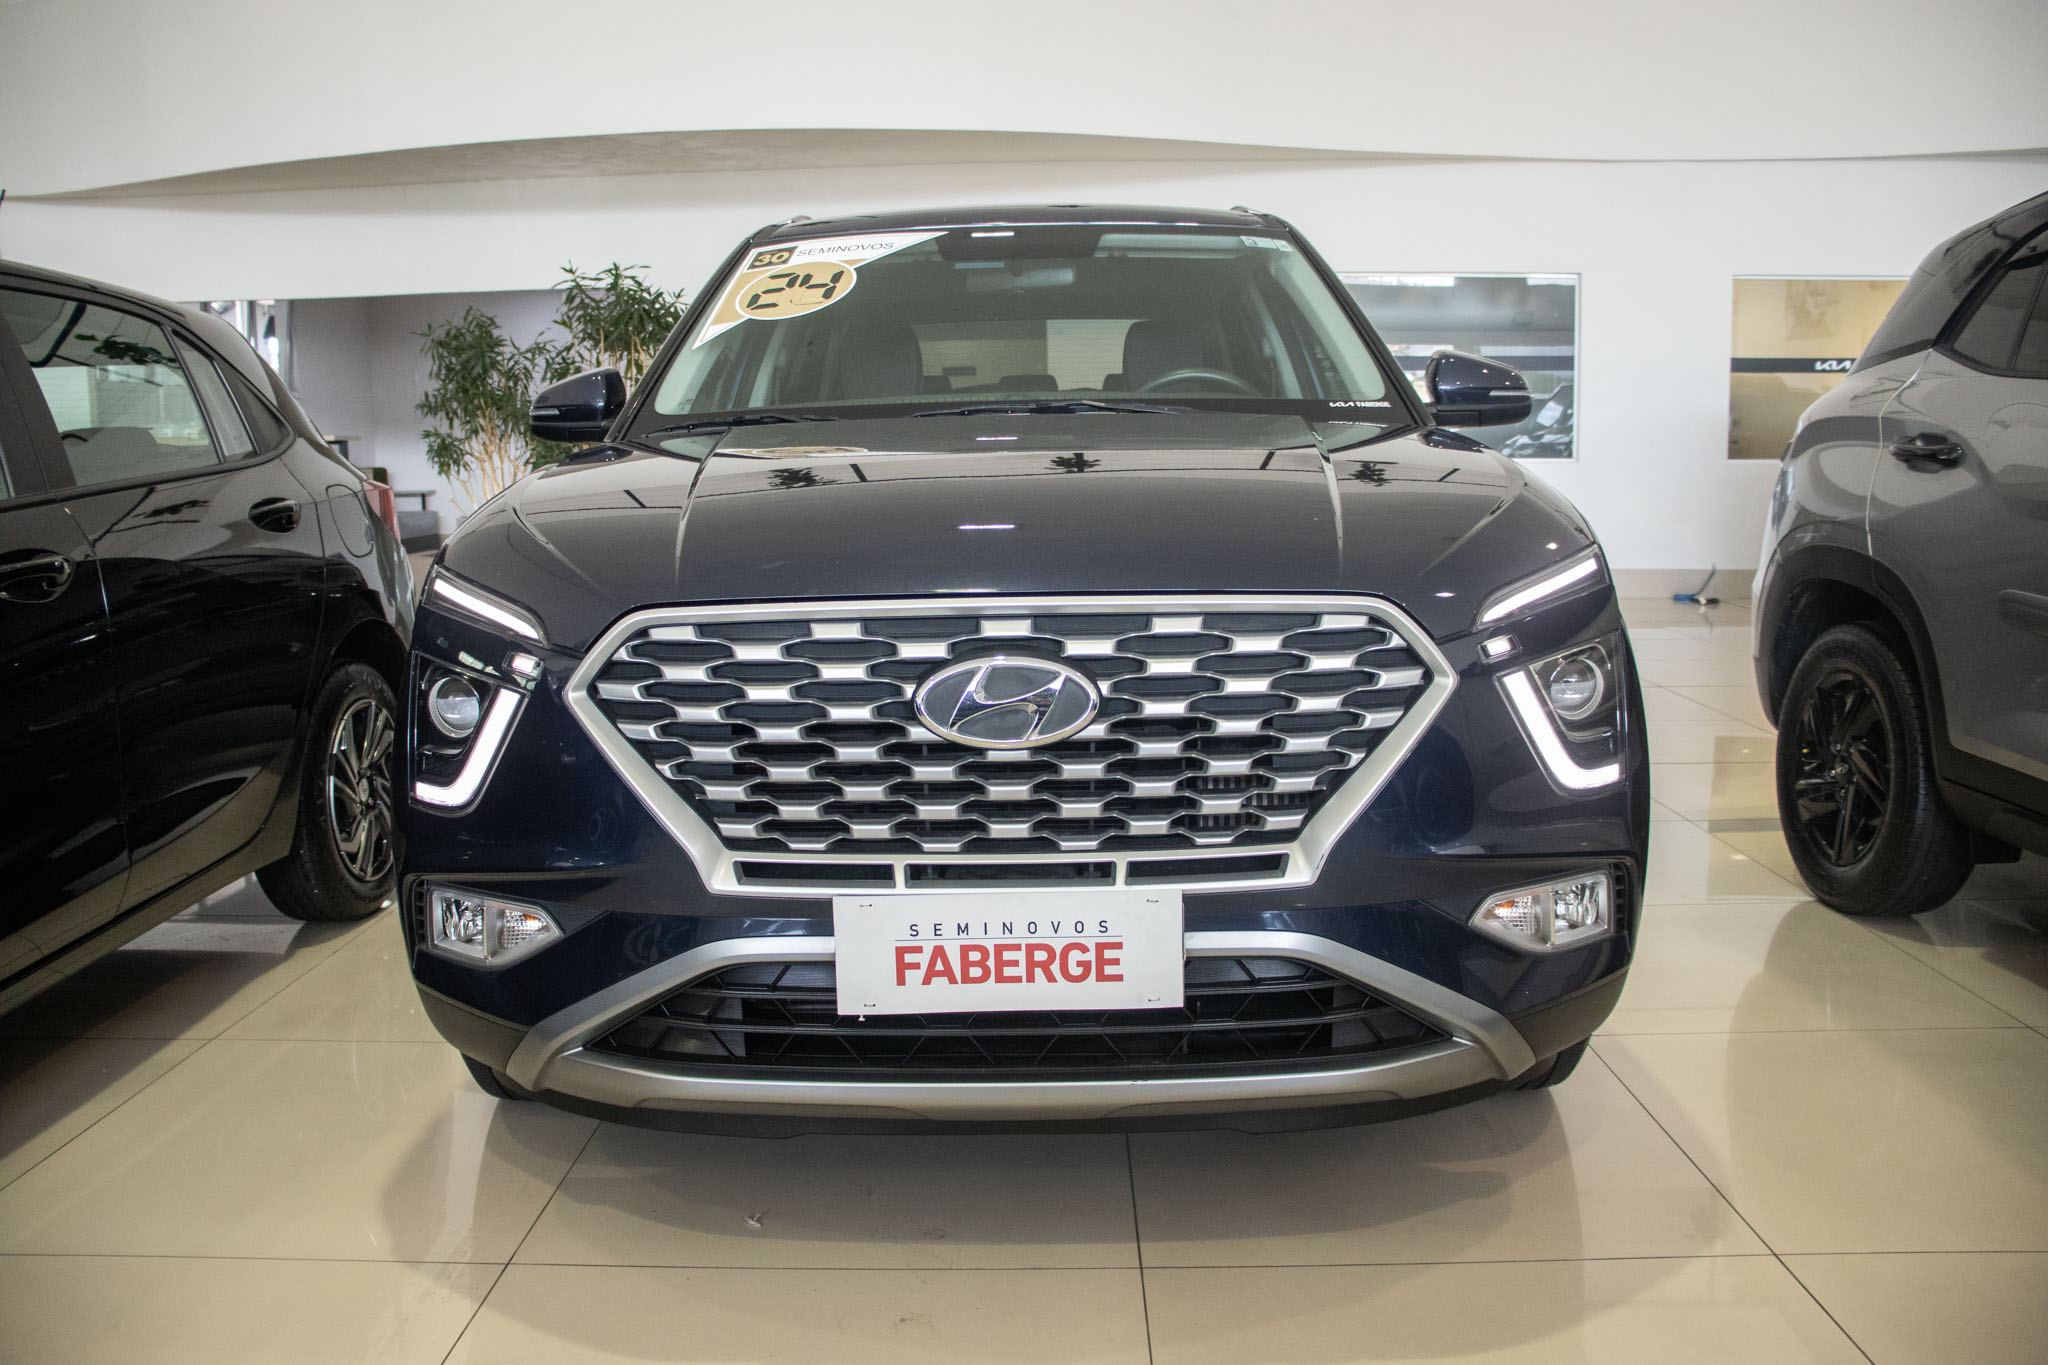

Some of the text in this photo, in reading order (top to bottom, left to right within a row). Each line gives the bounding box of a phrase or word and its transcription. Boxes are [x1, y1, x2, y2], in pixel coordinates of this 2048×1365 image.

[753, 242, 894, 266] 30 SEMINOVOS
[746, 270, 844, 310] 24
[909, 920, 1108, 937] SEMINOVOS
[894, 941, 1124, 986] FABERGE
